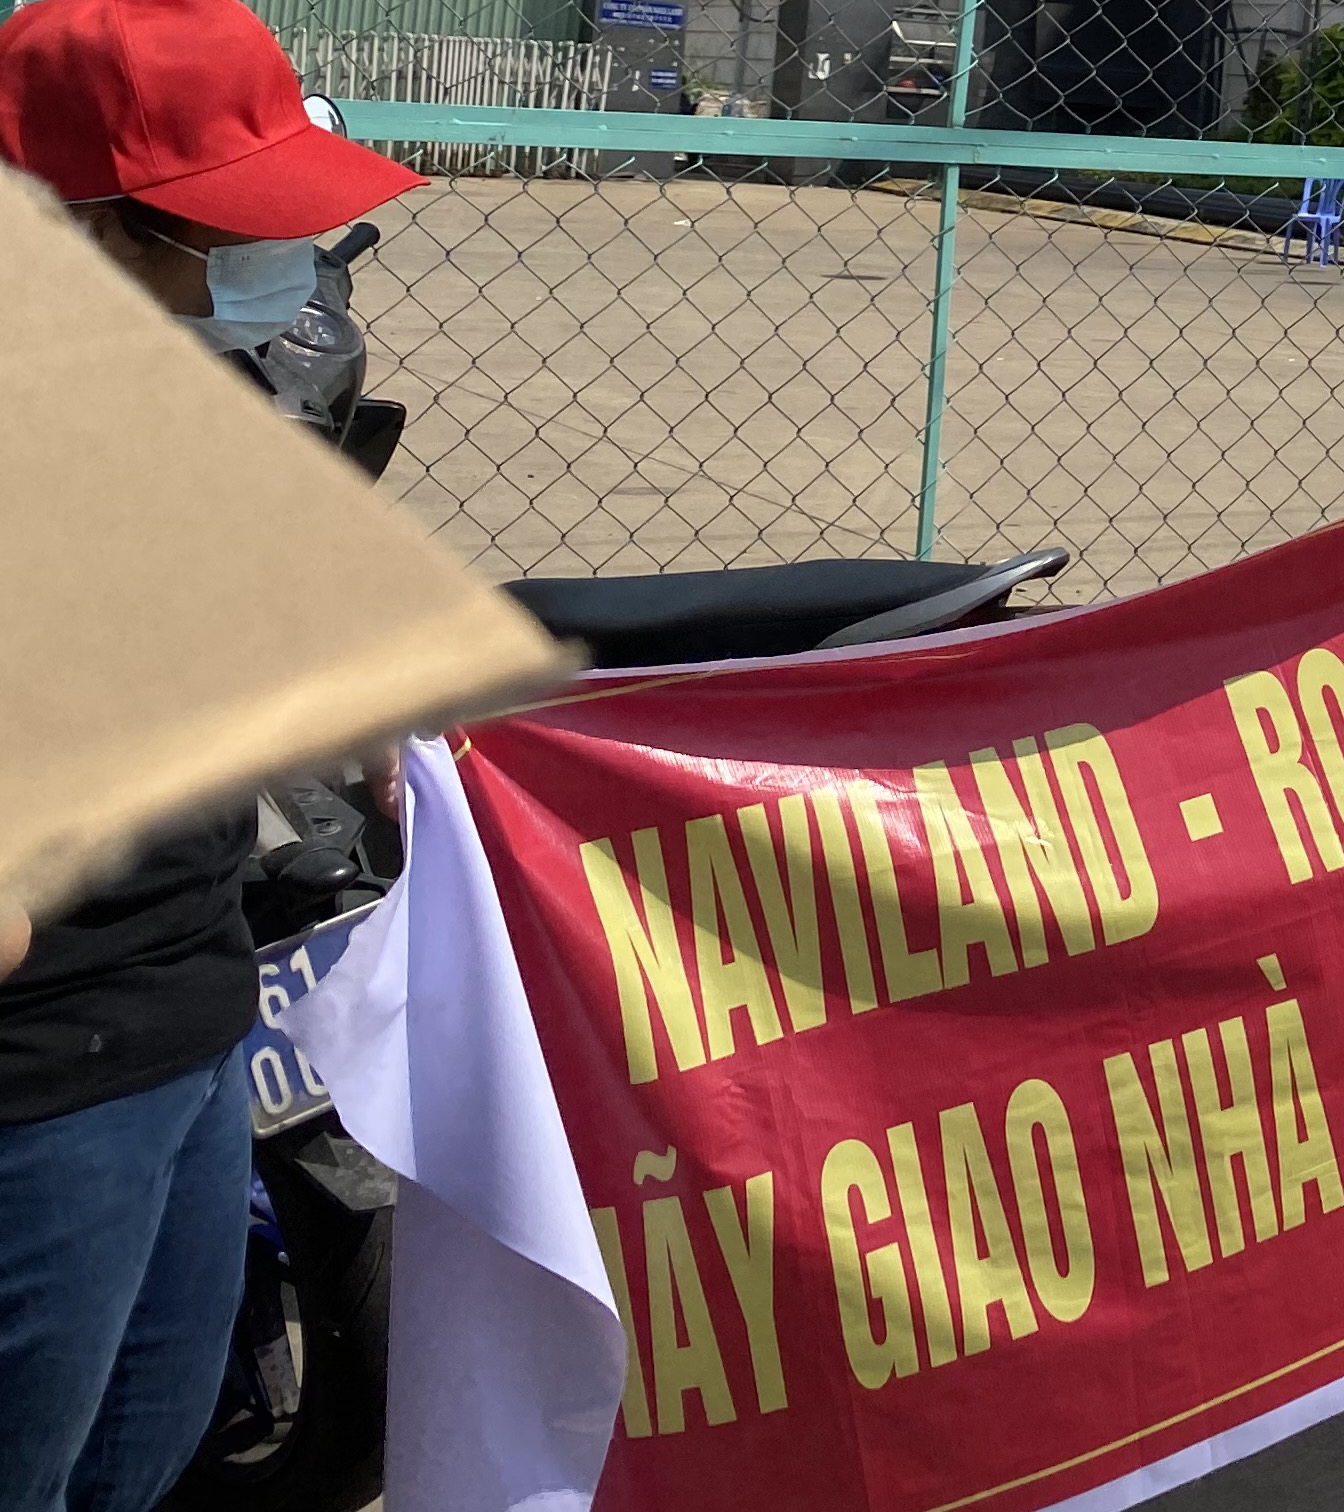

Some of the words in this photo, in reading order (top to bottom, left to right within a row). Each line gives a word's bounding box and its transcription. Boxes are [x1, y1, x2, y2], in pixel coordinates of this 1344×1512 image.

[579, 720, 1160, 1085] NAVILAND
[820, 1077, 1095, 1390] GIAO
[1103, 953, 1344, 1288] NHÀ
